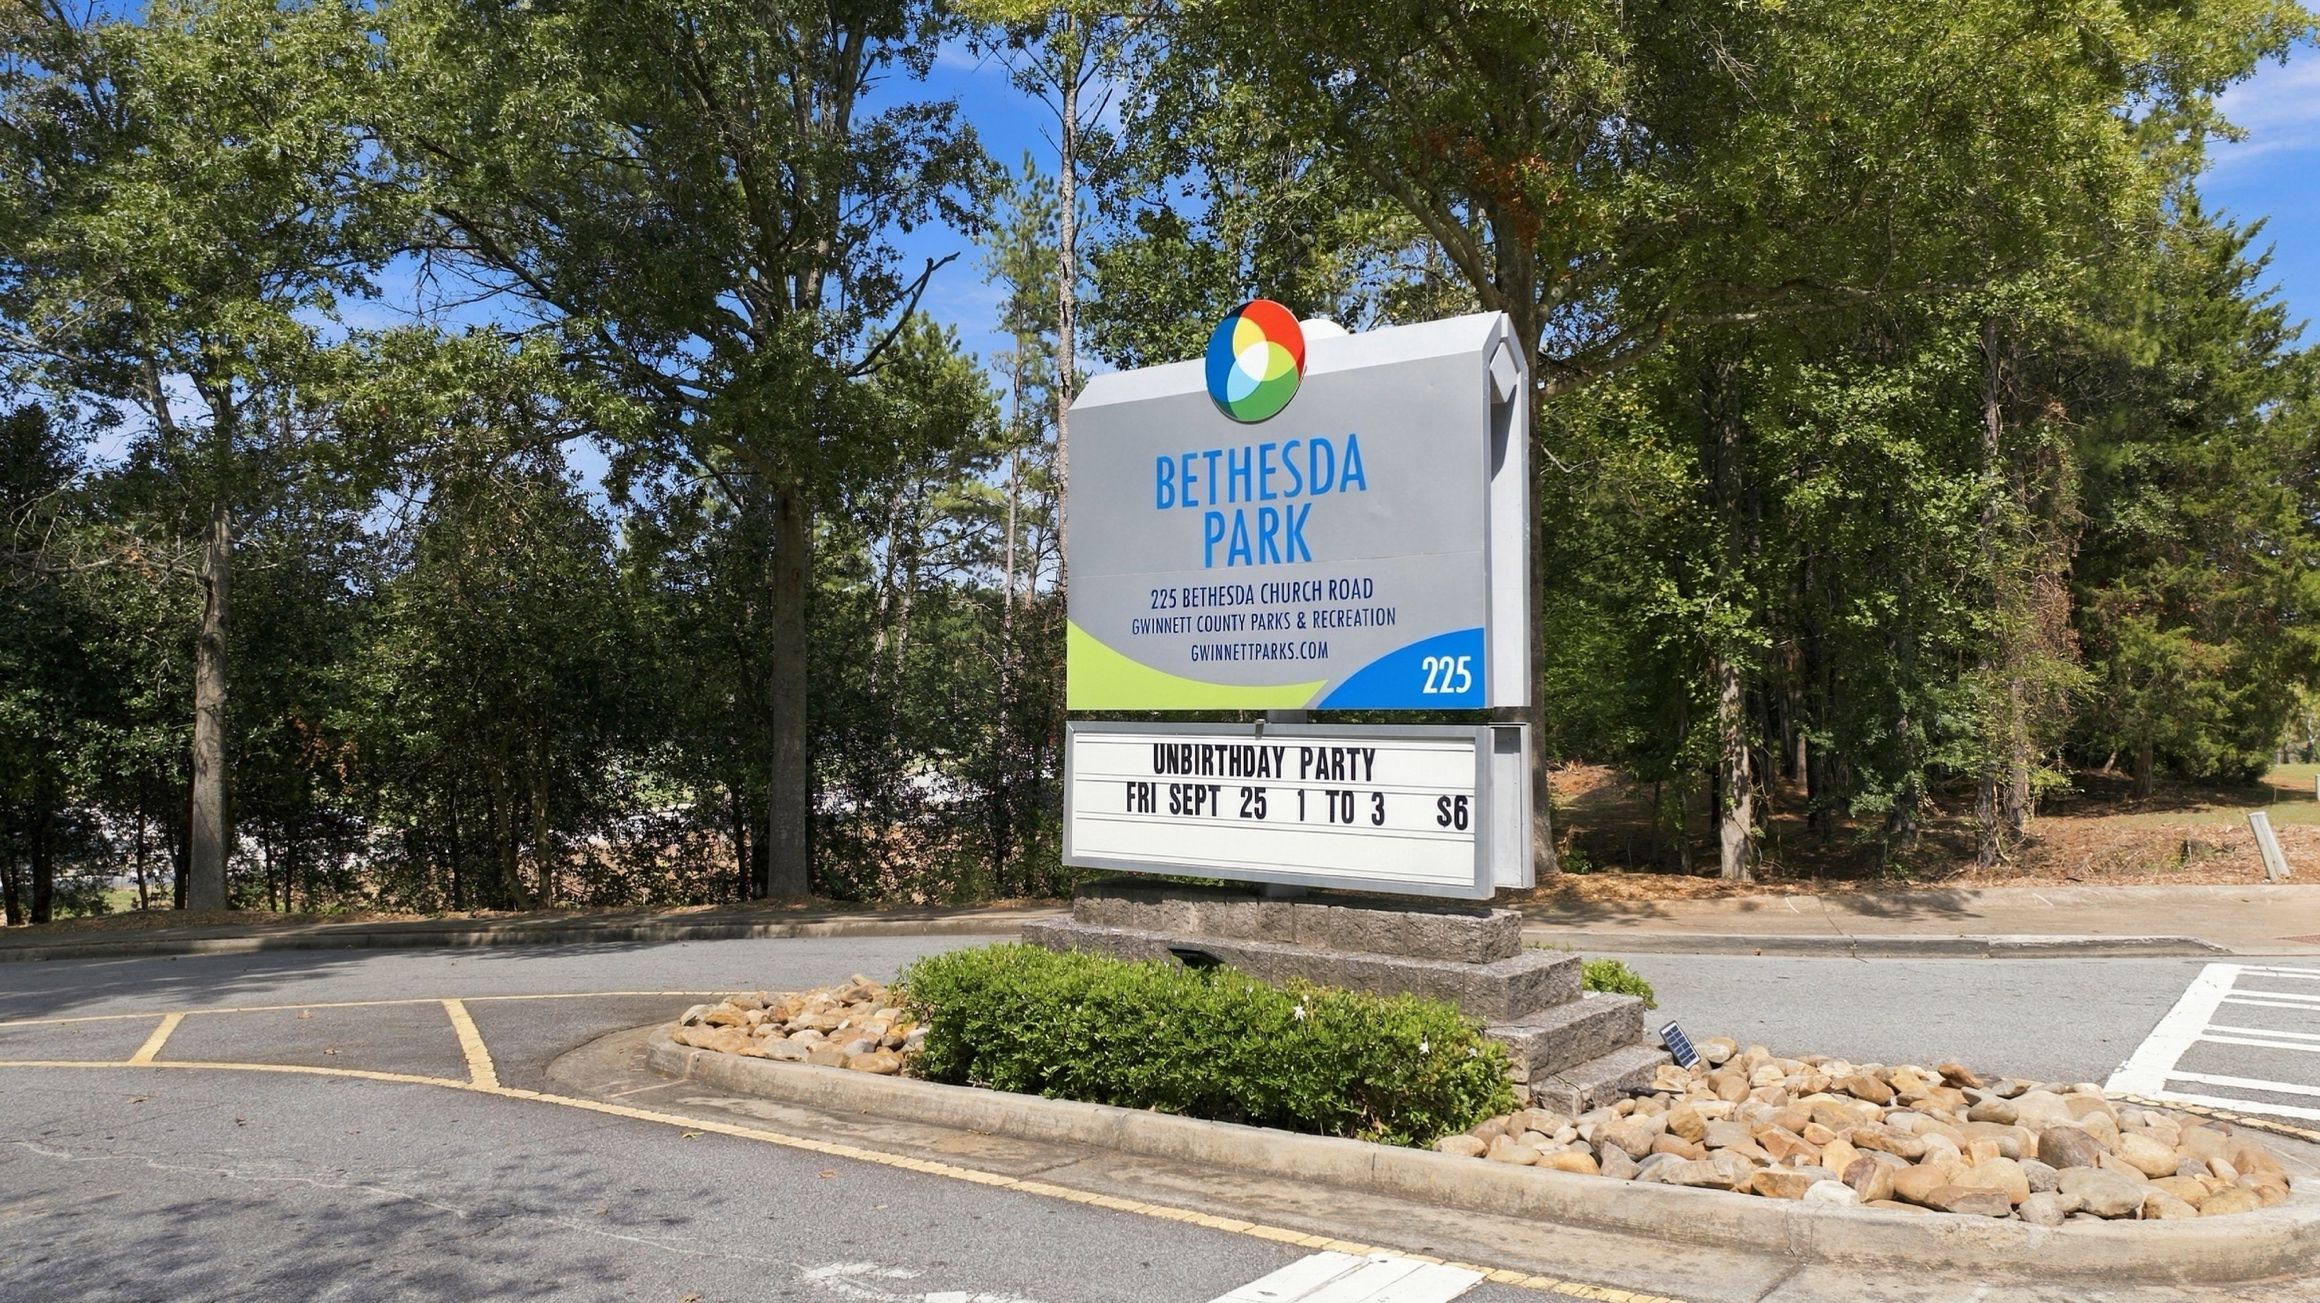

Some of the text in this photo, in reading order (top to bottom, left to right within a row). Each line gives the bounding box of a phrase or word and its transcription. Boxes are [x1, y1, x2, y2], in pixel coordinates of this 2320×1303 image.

[1155, 433, 1367, 510] BETHESDA
[1203, 502, 1312, 569] PARK
[1151, 577, 1374, 610] 225 BETHESDA CHURCH ROAD
[1132, 607, 1396, 635] GWINNETT COUNTY PARKS & RECREATION
[1191, 641, 1329, 662] GWINNETTPARKS.COM
[1422, 655, 1472, 694] 225
[1153, 743, 1376, 782] UNBIRTHDAY PARTY
[1126, 781, 1157, 814] FRI
[1169, 782, 1222, 817] SEPT
[1239, 786, 1267, 820] 25
[1297, 788, 1305, 822] 1
[1324, 789, 1357, 824] TO
[1371, 791, 1385, 826] 3
